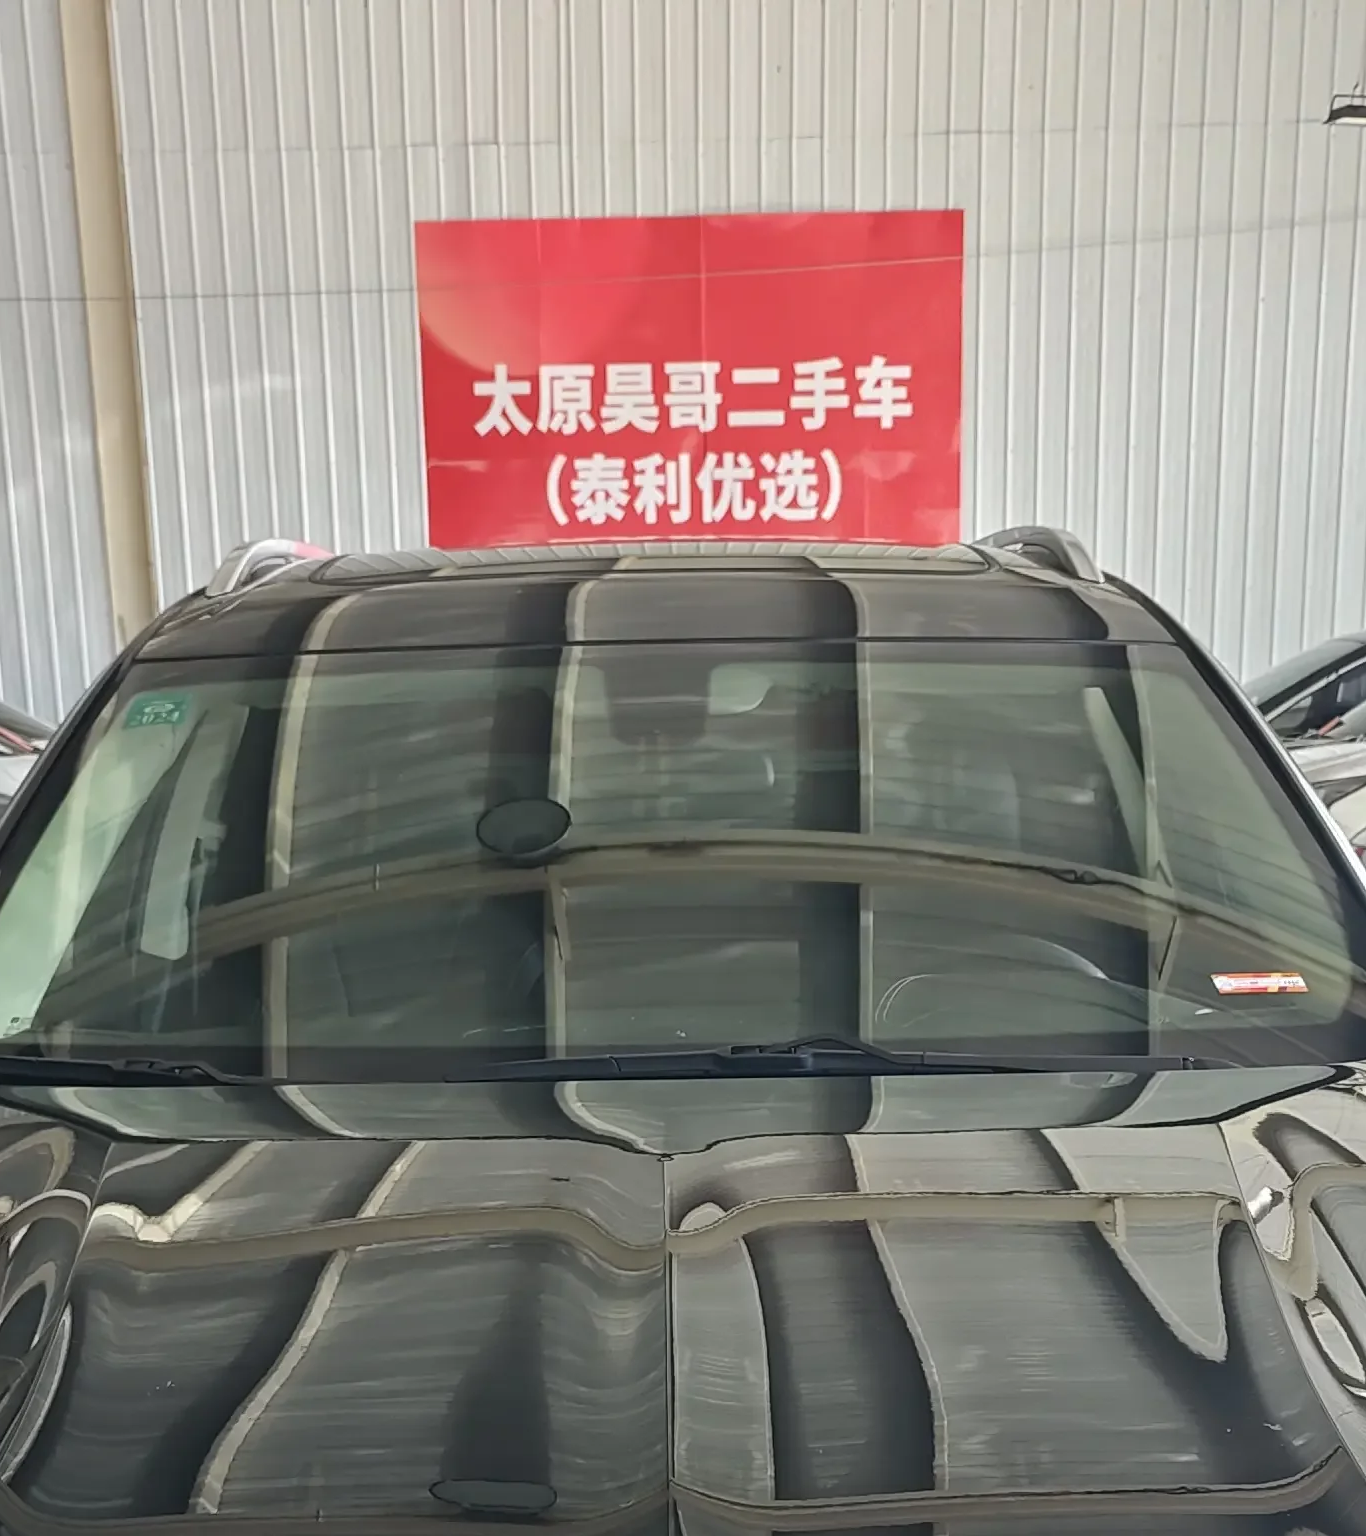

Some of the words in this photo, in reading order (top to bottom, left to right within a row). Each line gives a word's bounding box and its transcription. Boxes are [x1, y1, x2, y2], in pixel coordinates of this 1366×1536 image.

[473, 355, 913, 437] 太原昊哥二手车
[546, 448, 843, 526] (泰利优选)
